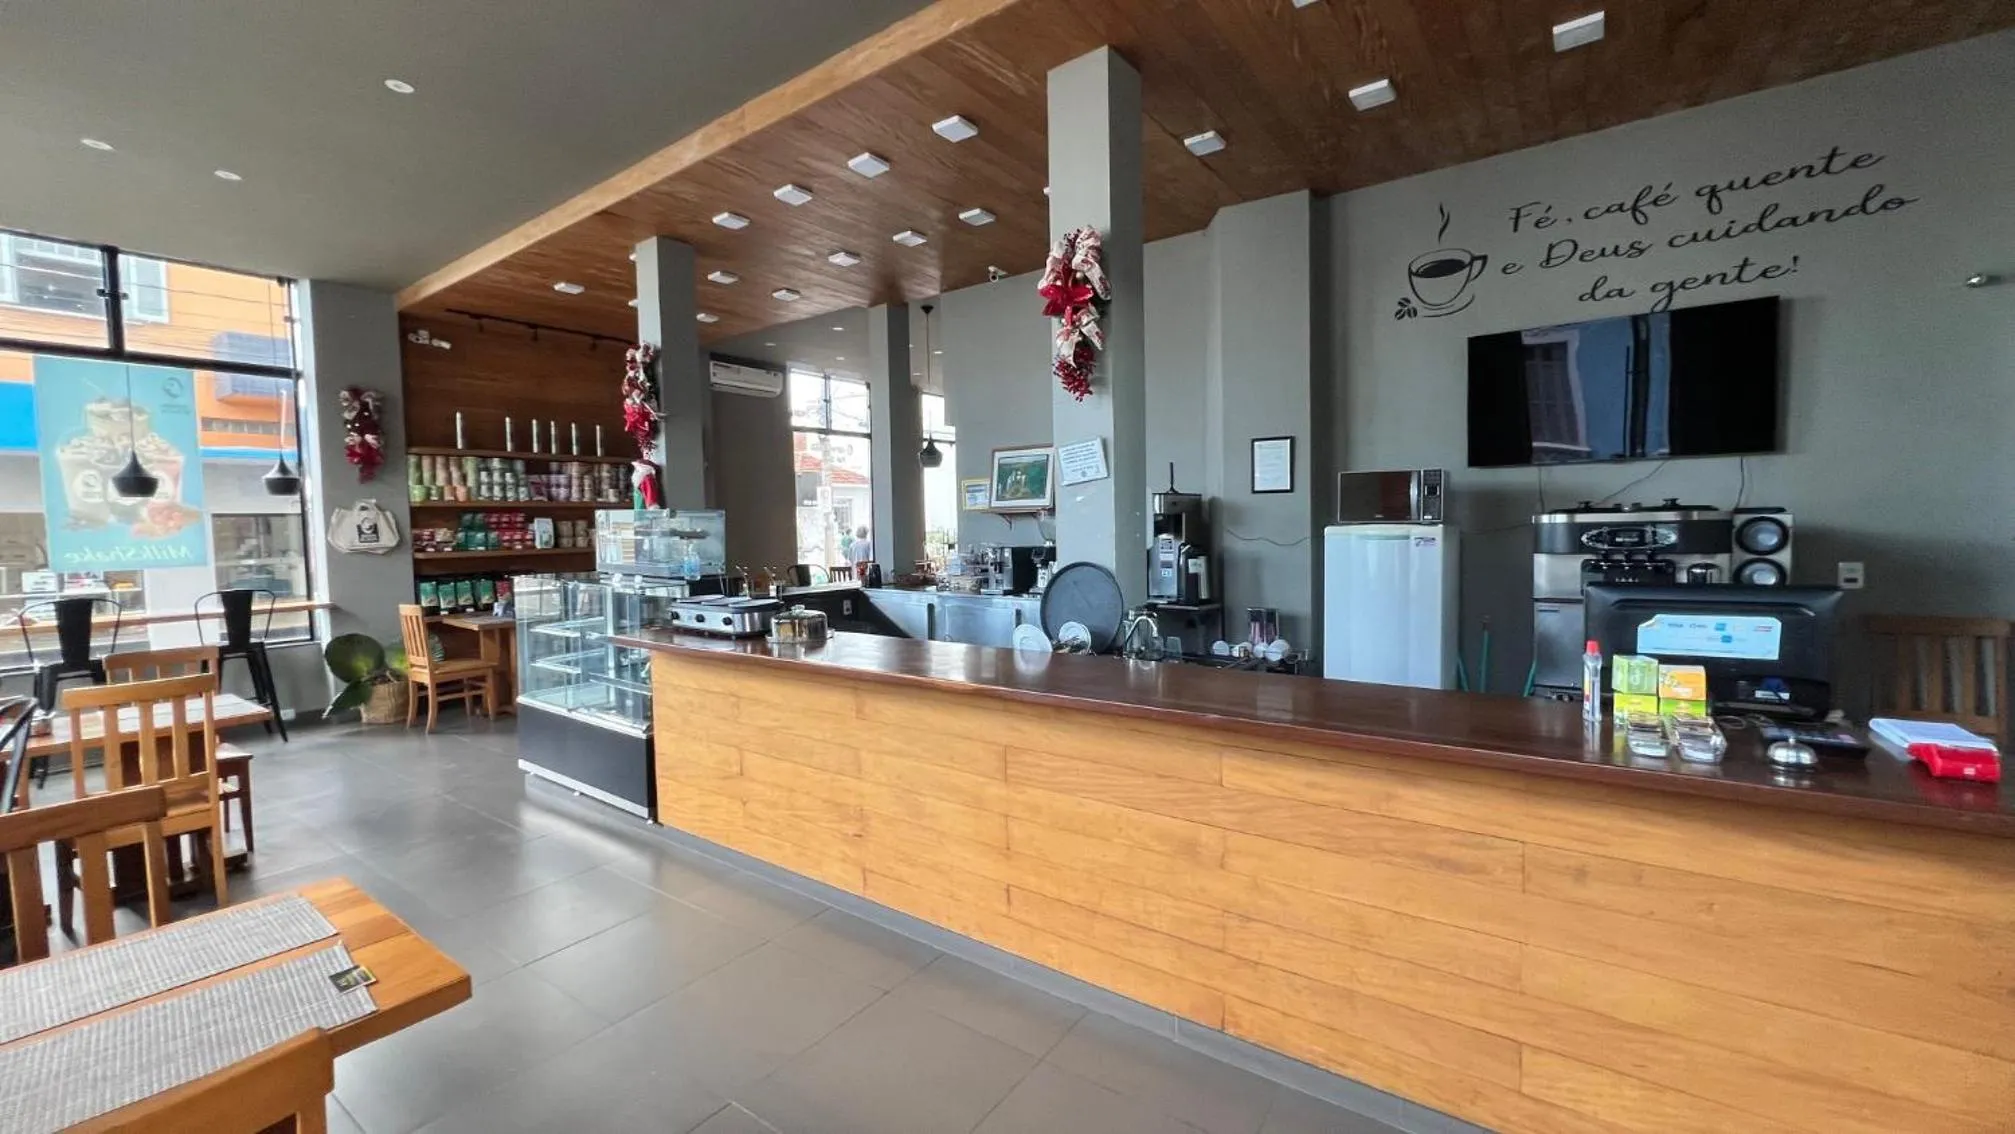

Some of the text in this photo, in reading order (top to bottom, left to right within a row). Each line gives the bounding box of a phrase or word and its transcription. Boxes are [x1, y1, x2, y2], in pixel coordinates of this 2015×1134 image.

[1584, 182, 1680, 225] café
[1695, 146, 1886, 215] quente
[1501, 184, 1921, 275] e Deus cuidando
[1578, 255, 1799, 312] da gente!
